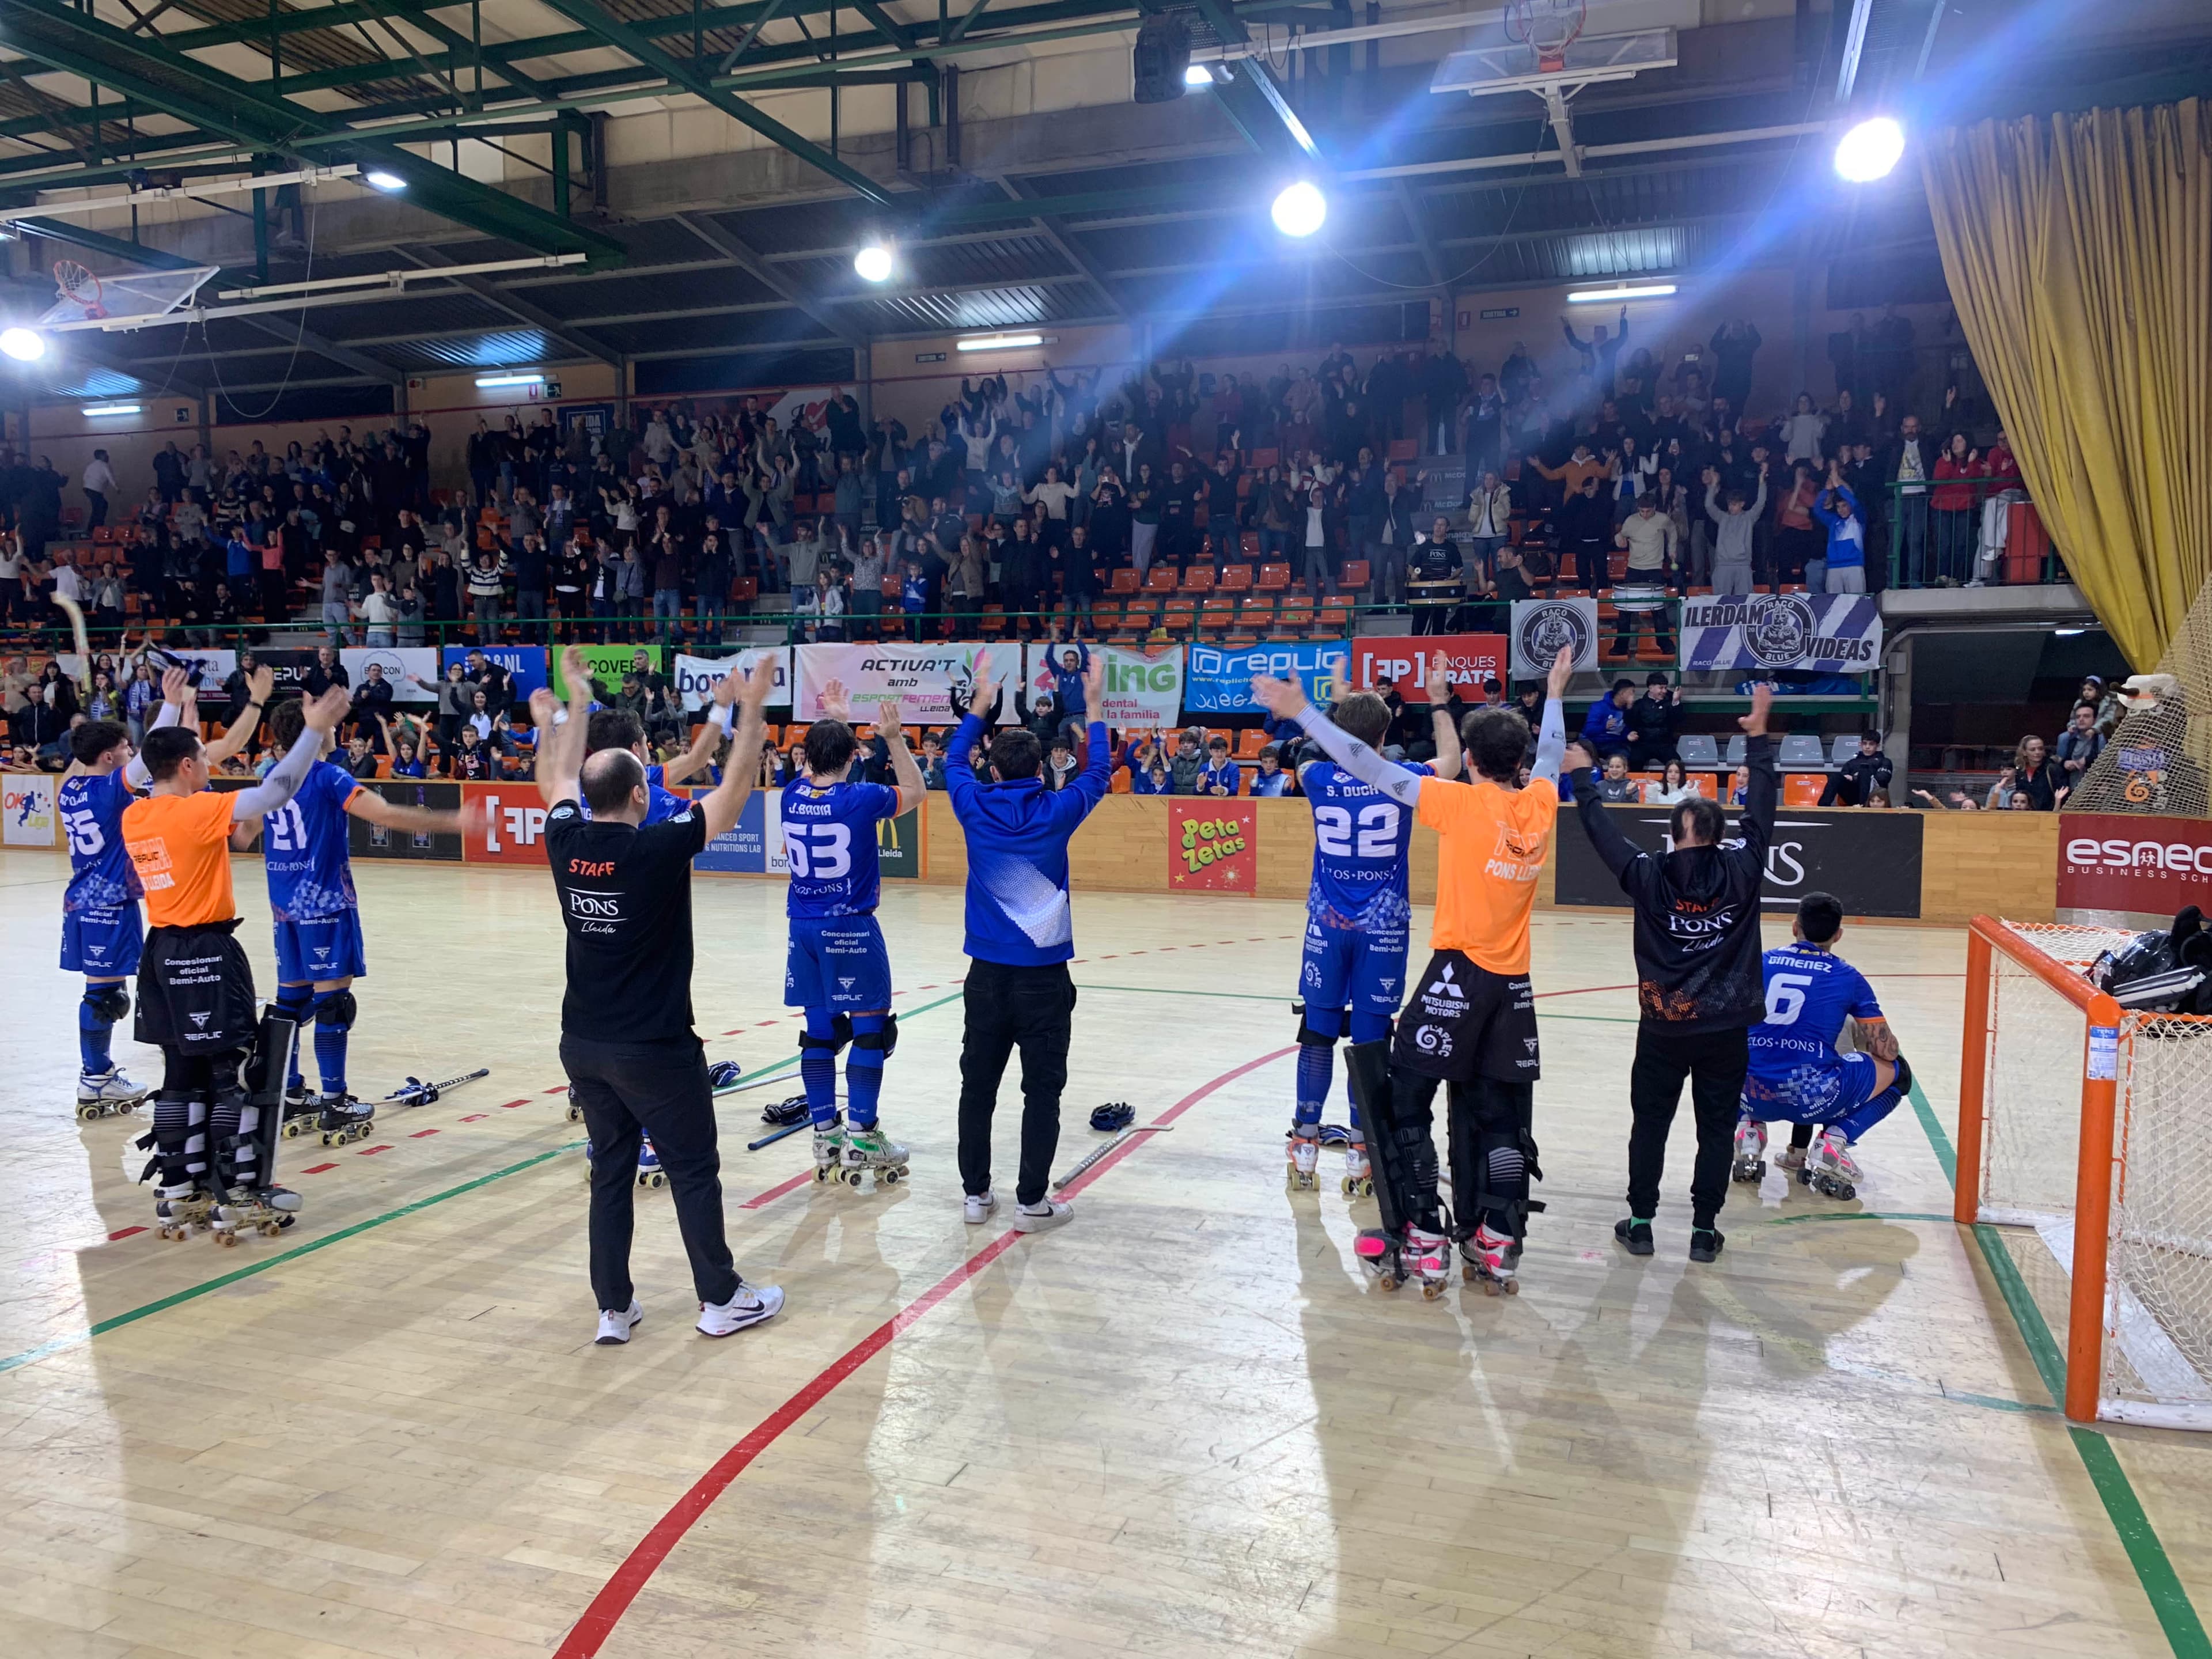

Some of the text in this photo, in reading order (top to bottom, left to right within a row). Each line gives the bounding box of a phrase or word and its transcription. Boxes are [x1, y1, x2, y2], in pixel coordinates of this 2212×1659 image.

[1685, 604, 1767, 628] ILERDAM
[1805, 636, 1874, 661] VIDEAS
[1765, 653, 1790, 661] BLUE
[861, 659, 956, 671] ACTIVA'T
[888, 678, 918, 687] amb
[1103, 699, 1137, 707] dental
[1107, 710, 1116, 718] la
[1327, 786, 1338, 797] S.
[267, 798, 308, 851] 21
[1315, 803, 1400, 857] 22
[738, 833, 759, 842] SPORT
[1182, 818, 1240, 849] Peta
[711, 843, 748, 853] NUTRITIONS
[749, 844, 761, 853] LAB
[782, 821, 851, 879] 63
[1182, 837, 1245, 873] Zetas
[569, 858, 615, 877] STAFF
[1484, 858, 1517, 880] PONS
[2067, 866, 2167, 879] BUSINESS
[570, 893, 619, 916] PONS
[1669, 911, 1733, 931] PONS
[165, 955, 222, 966] Concesionari
[1768, 956, 1833, 973] GIMENEZ
[179, 966, 209, 975] oficial
[169, 974, 221, 985] Bemi-Auto
[1421, 994, 1469, 1010] MITSUBISHI
[1763, 972, 1813, 1025] 6
[1425, 1005, 1461, 1017] MOTORS
[184, 1031, 222, 1041] REPLIC
